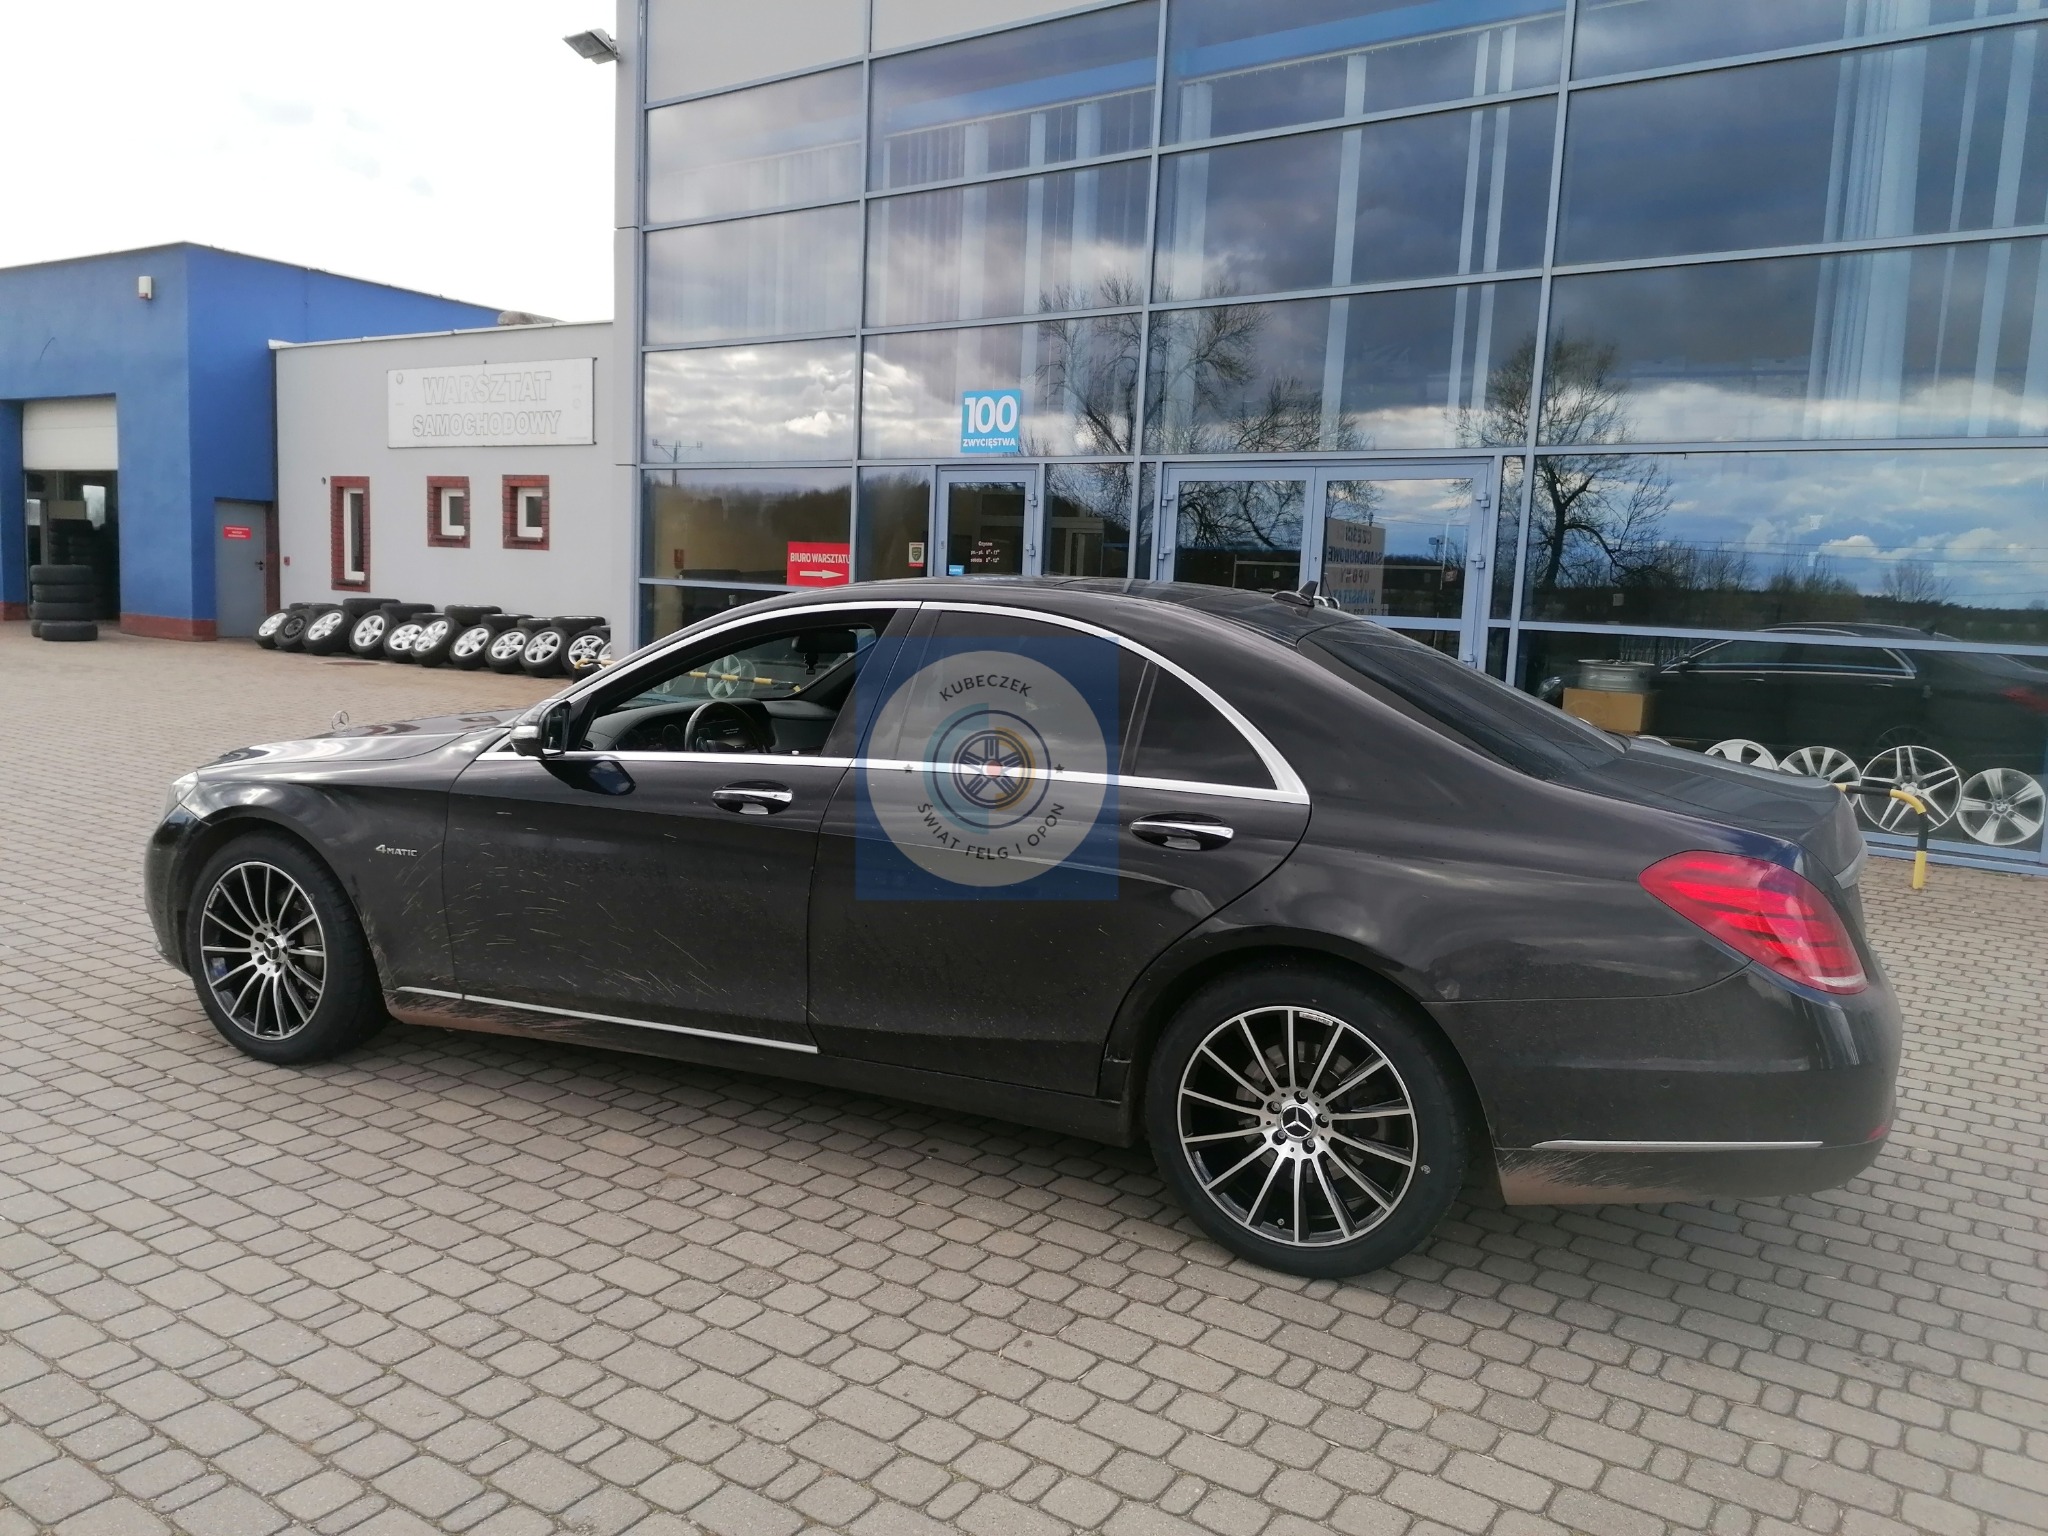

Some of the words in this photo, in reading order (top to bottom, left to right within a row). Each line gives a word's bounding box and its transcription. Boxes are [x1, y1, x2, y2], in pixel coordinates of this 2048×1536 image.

[422, 371, 552, 405] WARSZTAT
[412, 409, 562, 438] SAMOCHODOWY
[964, 395, 1018, 434] 100
[962, 437, 1016, 449] ZWYCIĘSTWA
[790, 552, 811, 563] BIURO
[375, 844, 418, 857] 4MATIC
